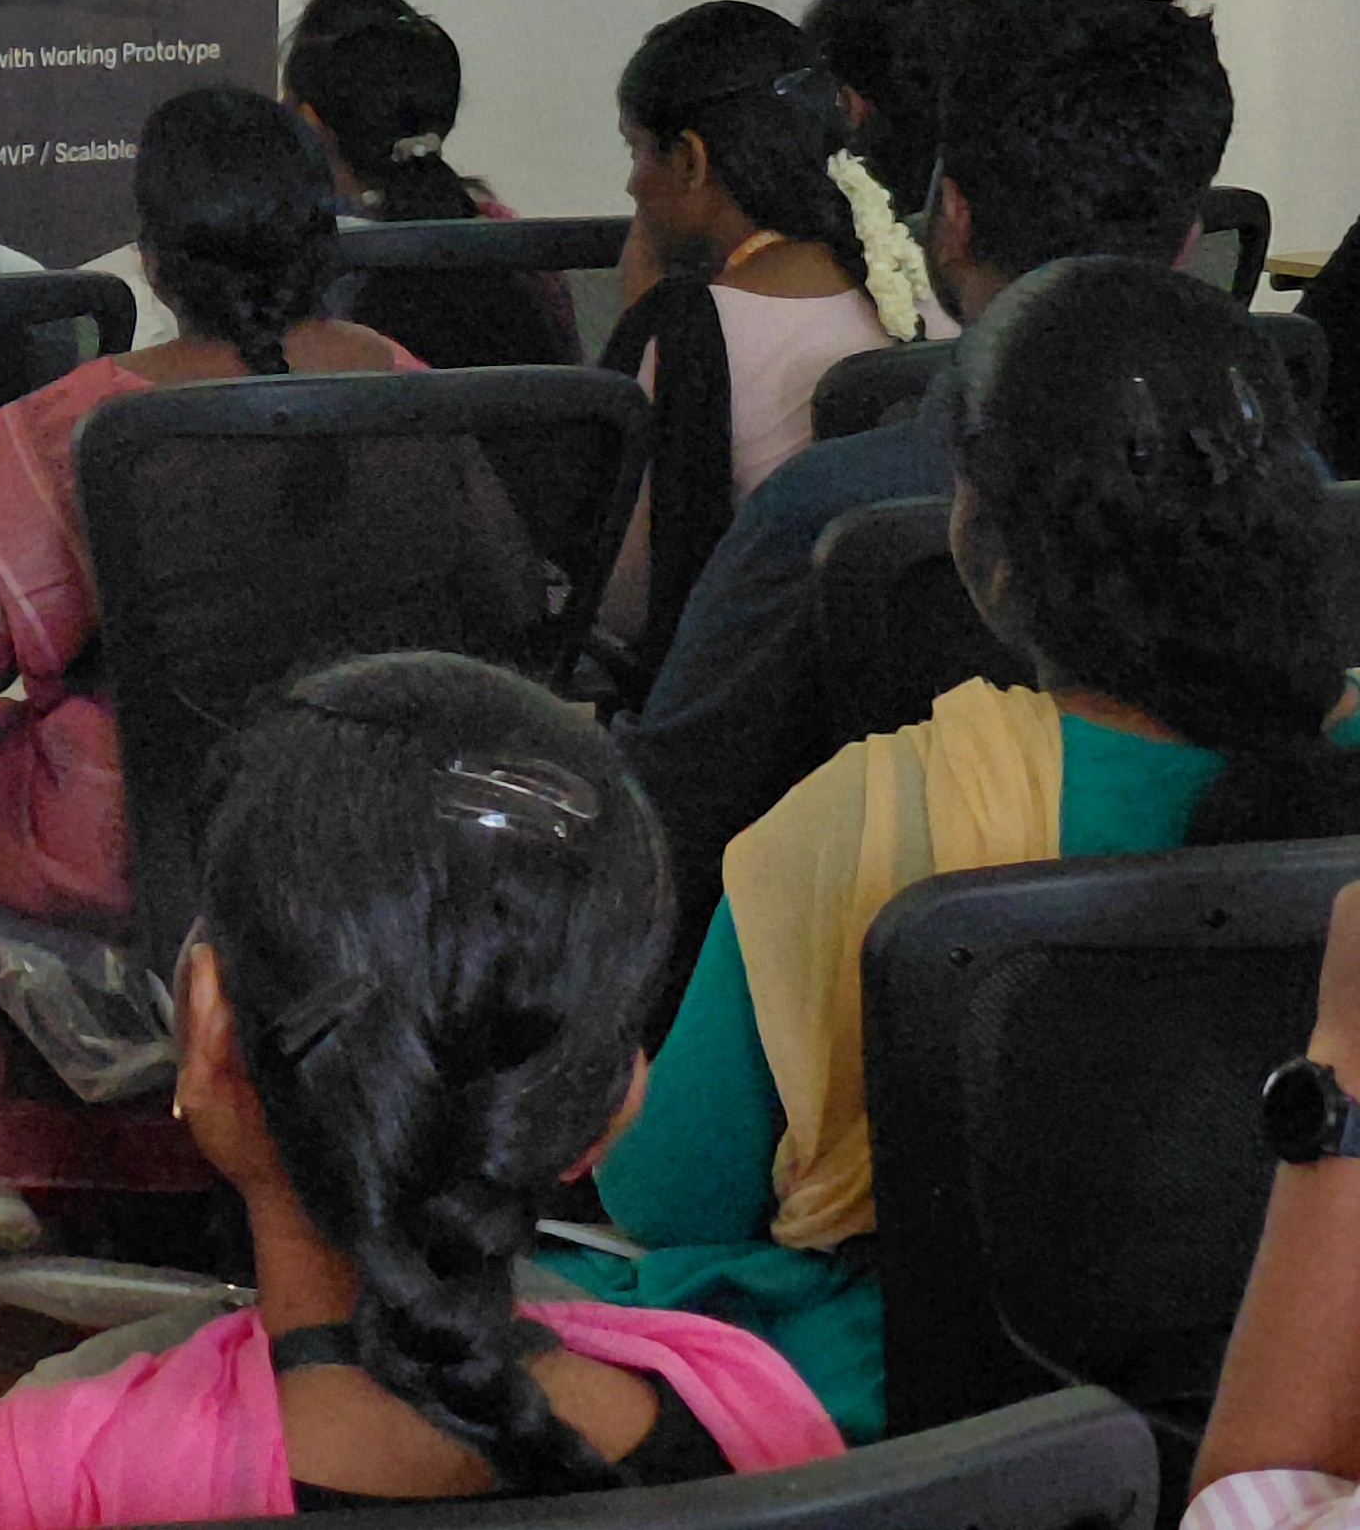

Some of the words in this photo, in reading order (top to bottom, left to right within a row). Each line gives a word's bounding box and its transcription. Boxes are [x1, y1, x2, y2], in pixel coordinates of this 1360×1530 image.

[40, 43, 118, 70] Working
[122, 39, 222, 65] Prototype
[39, 141, 50, 166] /
